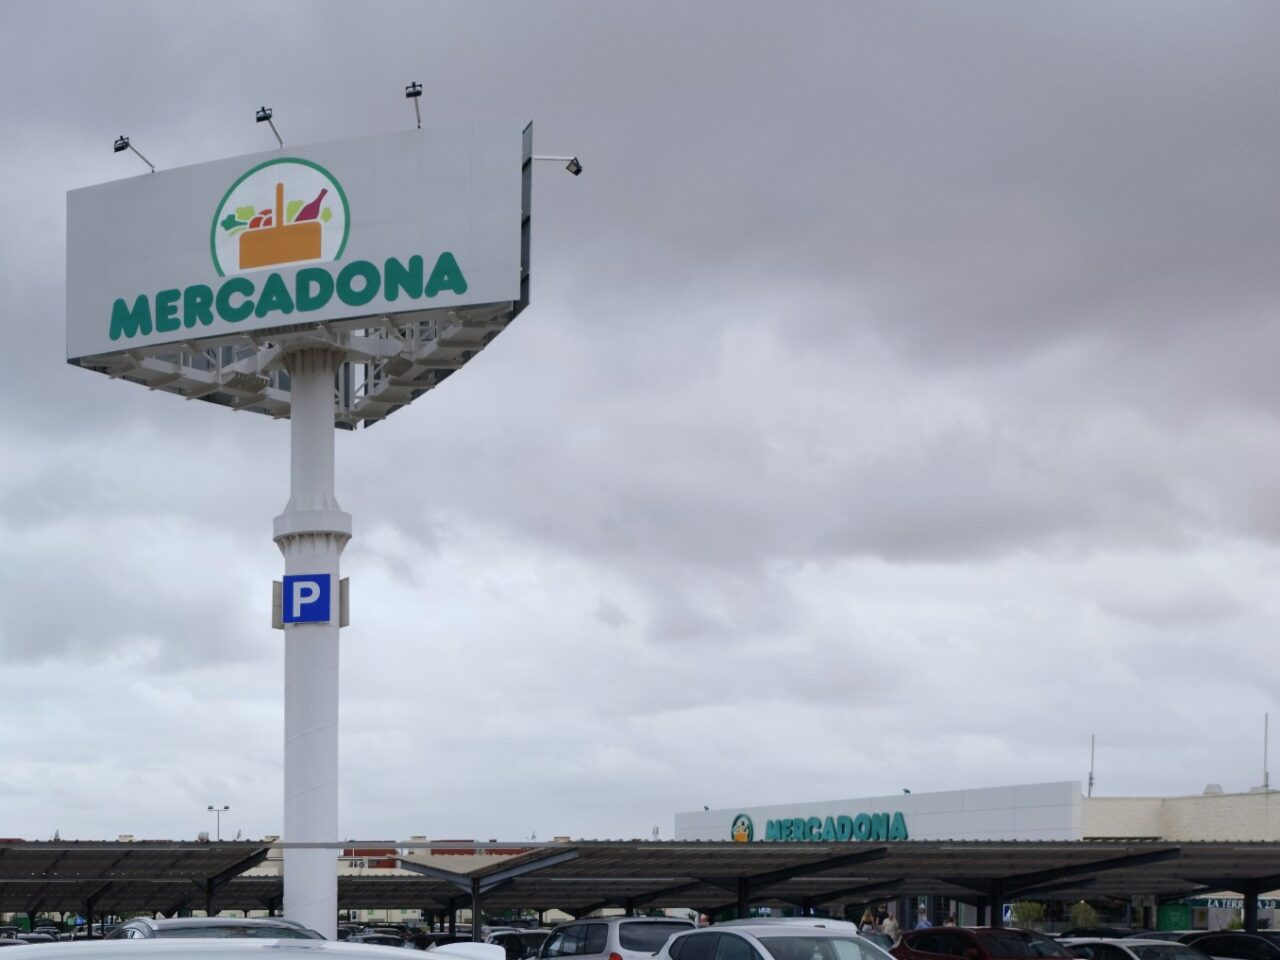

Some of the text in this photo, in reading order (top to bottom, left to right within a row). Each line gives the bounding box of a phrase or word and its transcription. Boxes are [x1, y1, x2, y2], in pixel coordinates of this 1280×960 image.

[109, 251, 468, 341] MERCADONA
[292, 581, 321, 618] P
[765, 811, 909, 841] MERCADONA
[1207, 899, 1218, 908] LA
